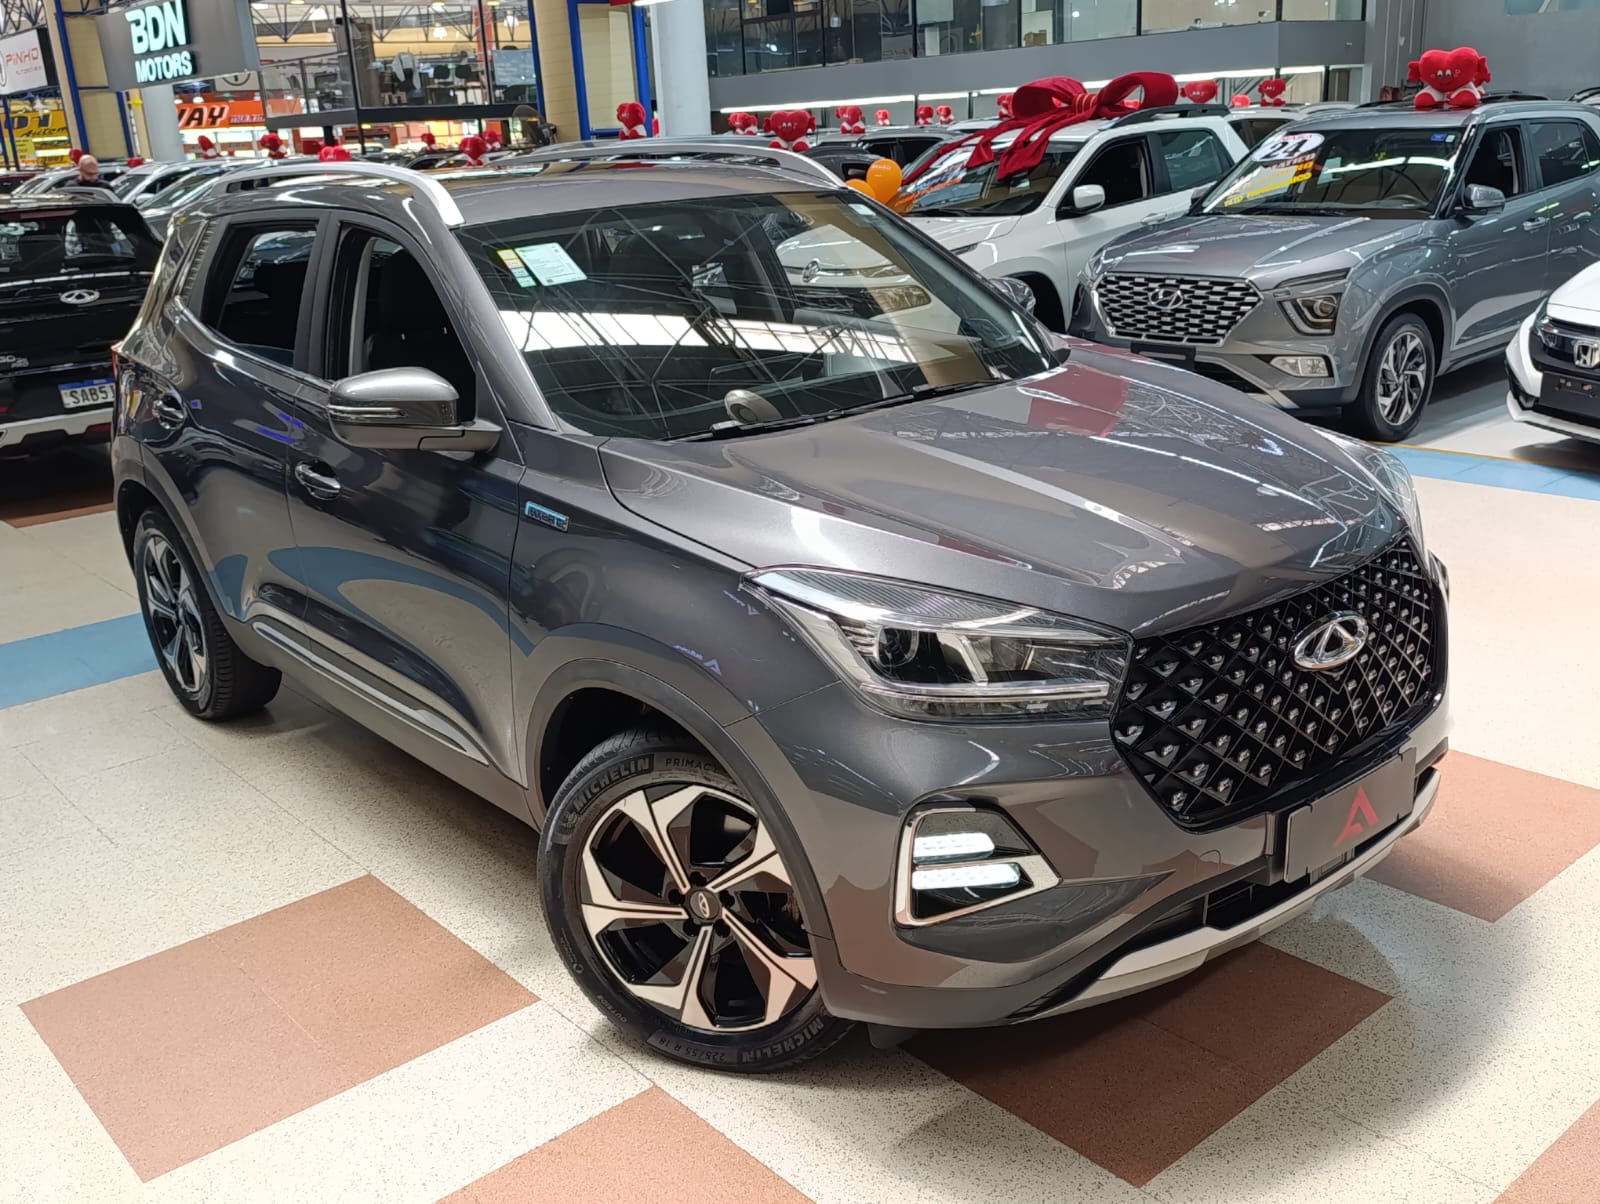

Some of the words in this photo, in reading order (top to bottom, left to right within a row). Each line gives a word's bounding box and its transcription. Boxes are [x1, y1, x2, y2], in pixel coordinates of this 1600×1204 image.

[125, 0, 186, 54] BDN
[135, 50, 192, 83] MOTORS
[572, 757, 650, 813] MICHELIN
[685, 1046, 727, 1062] 225/55
[742, 1017, 825, 1063] MICHELIN
